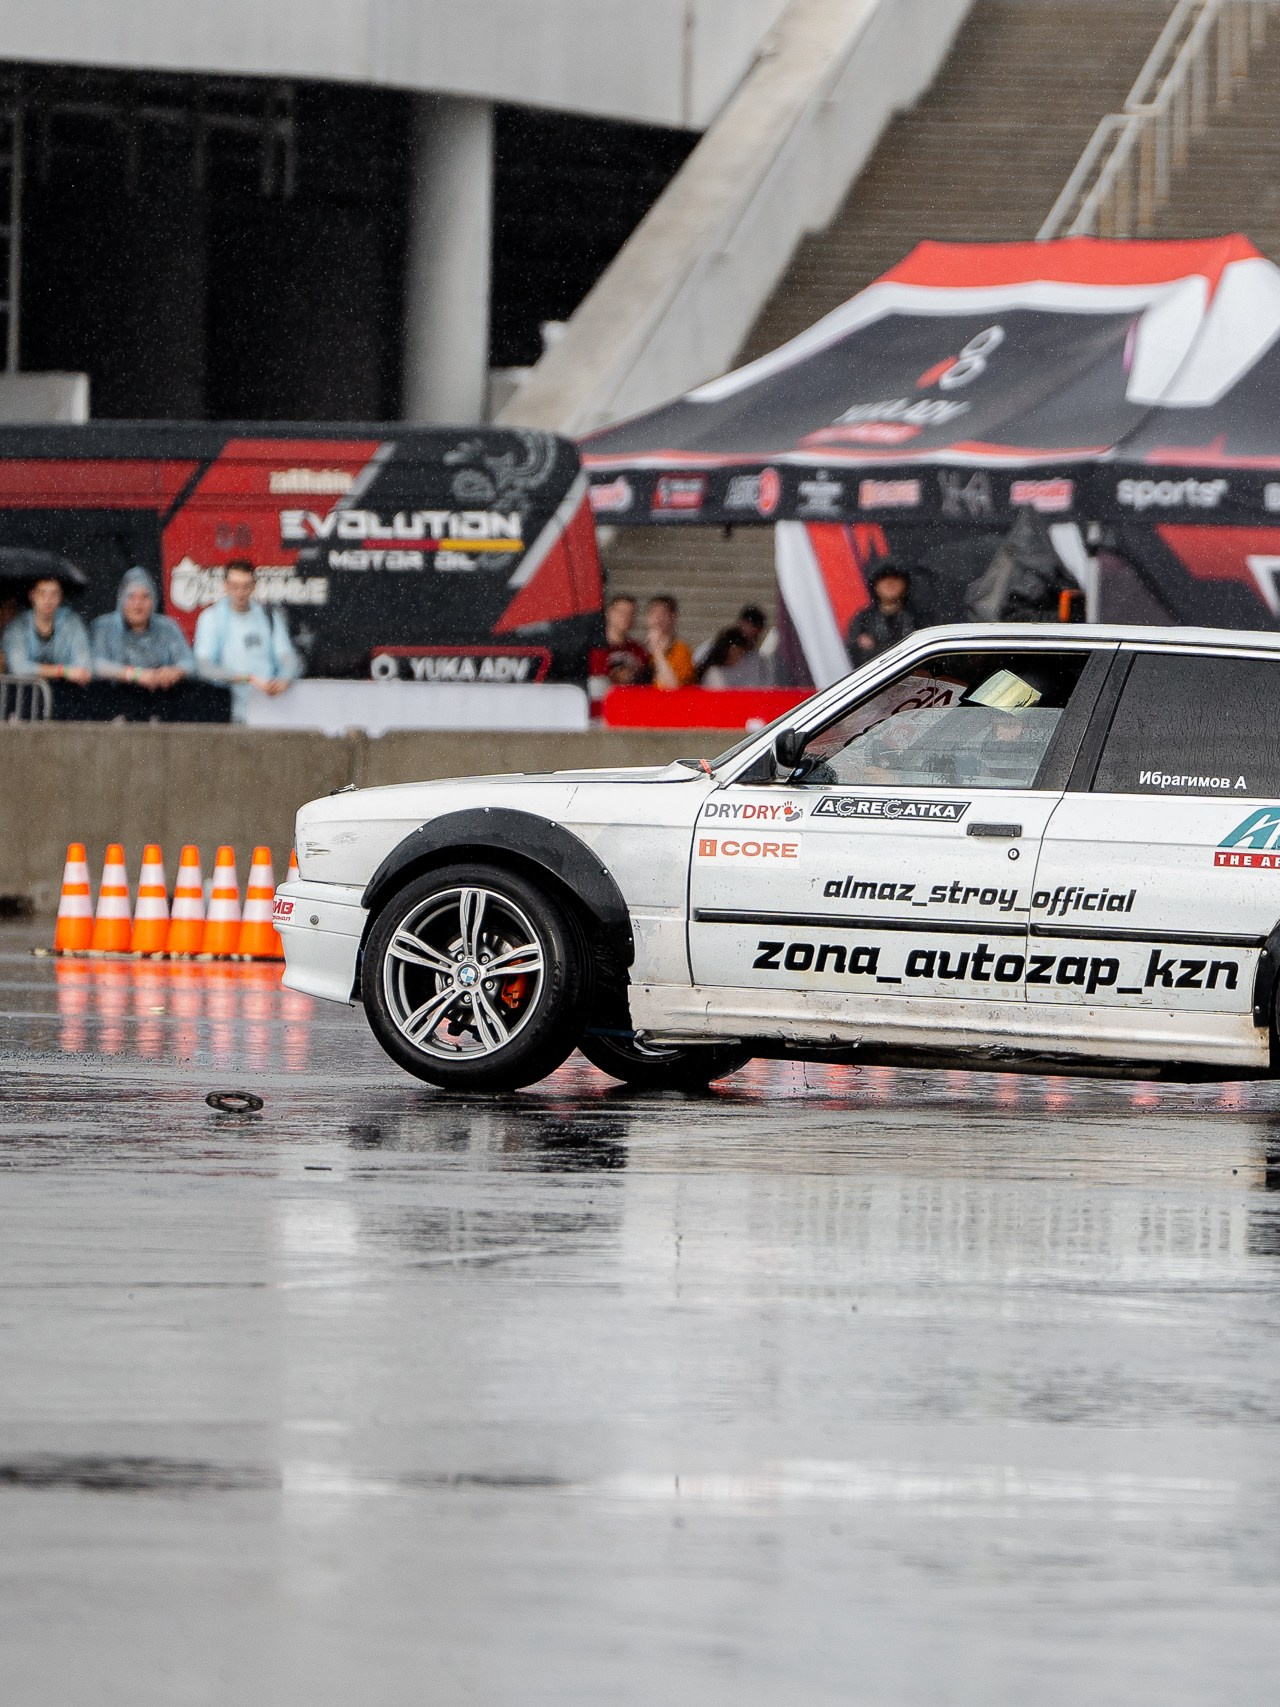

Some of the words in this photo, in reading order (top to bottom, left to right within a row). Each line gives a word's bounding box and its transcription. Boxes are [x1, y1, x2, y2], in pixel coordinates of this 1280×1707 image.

[280, 510, 522, 540] EVOLUTION
[409, 656, 477, 682] YUKA
[478, 656, 530, 682] ADV
[1139, 771, 1231, 790] Ибрагимов
[704, 803, 781, 820] DRYDRY
[820, 798, 957, 819] AGREGATKA
[1218, 854, 1254, 866] THE
[823, 875, 1136, 916] almaz_stroy_official
[752, 940, 1239, 994] zona_autozap_kzn
